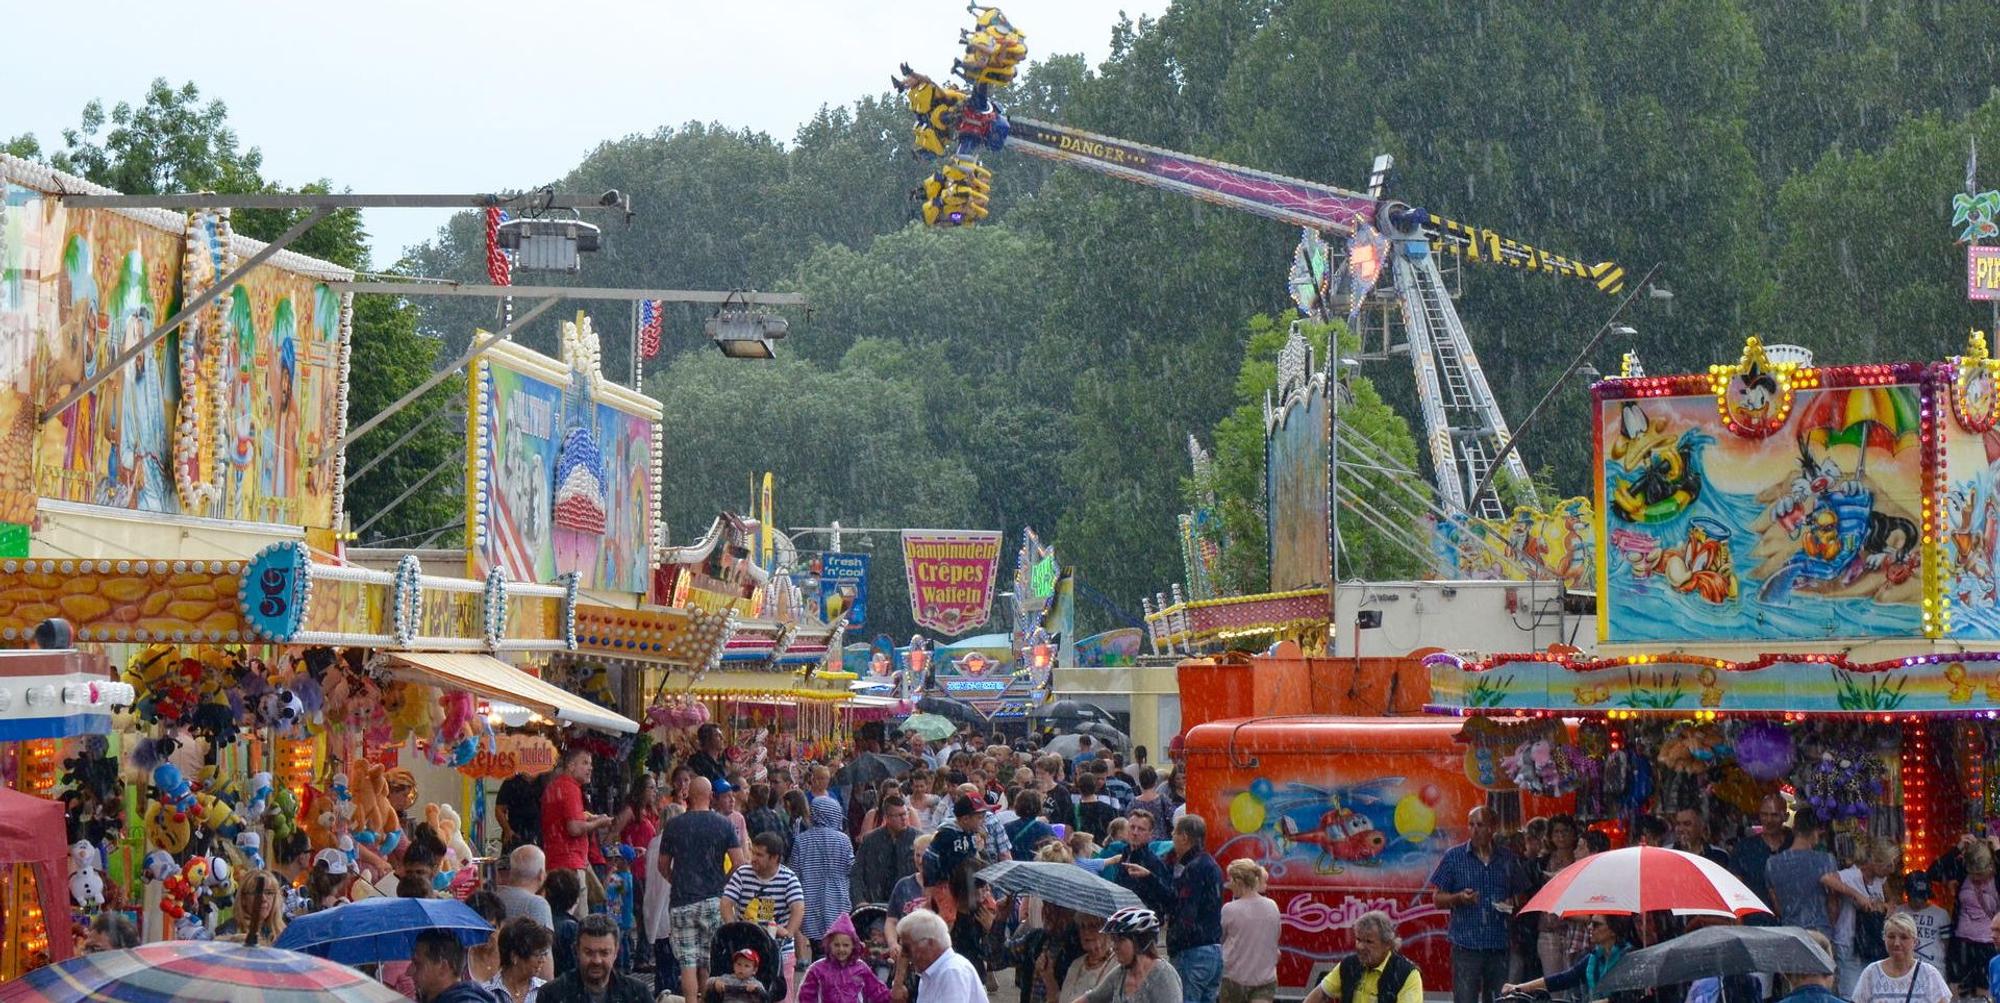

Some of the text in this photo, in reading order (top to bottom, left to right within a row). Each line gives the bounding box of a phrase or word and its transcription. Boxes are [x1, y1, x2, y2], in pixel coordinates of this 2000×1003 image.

[1059, 136, 1124, 162] DANGER
[828, 556, 862, 567] fresh
[918, 561, 983, 584] Crêpes
